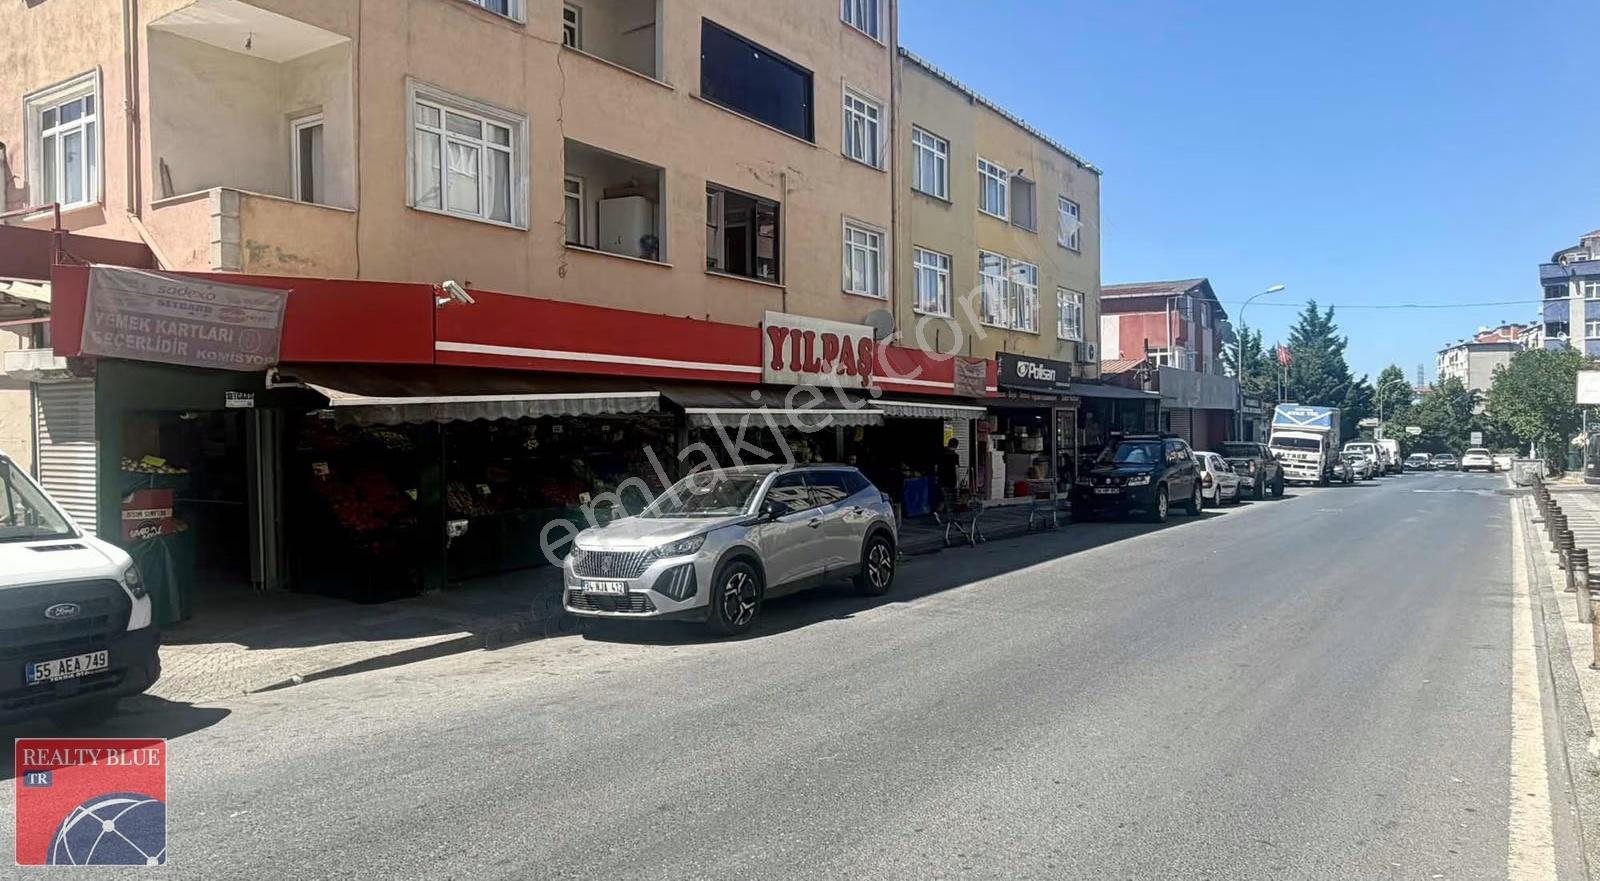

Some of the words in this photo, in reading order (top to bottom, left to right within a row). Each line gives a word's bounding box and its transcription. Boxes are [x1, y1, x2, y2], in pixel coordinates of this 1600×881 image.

[157, 284, 217, 301] sodexo
[95, 310, 151, 333] YEMEK
[155, 319, 234, 345] KARTLARI
[766, 325, 873, 387] YILPAŞ
[1028, 362, 1056, 382] Polisan
[55, 606, 75, 617] Ford
[36, 663, 51, 680] 55
[59, 657, 81, 675] AEA
[85, 652, 106, 670] 749
